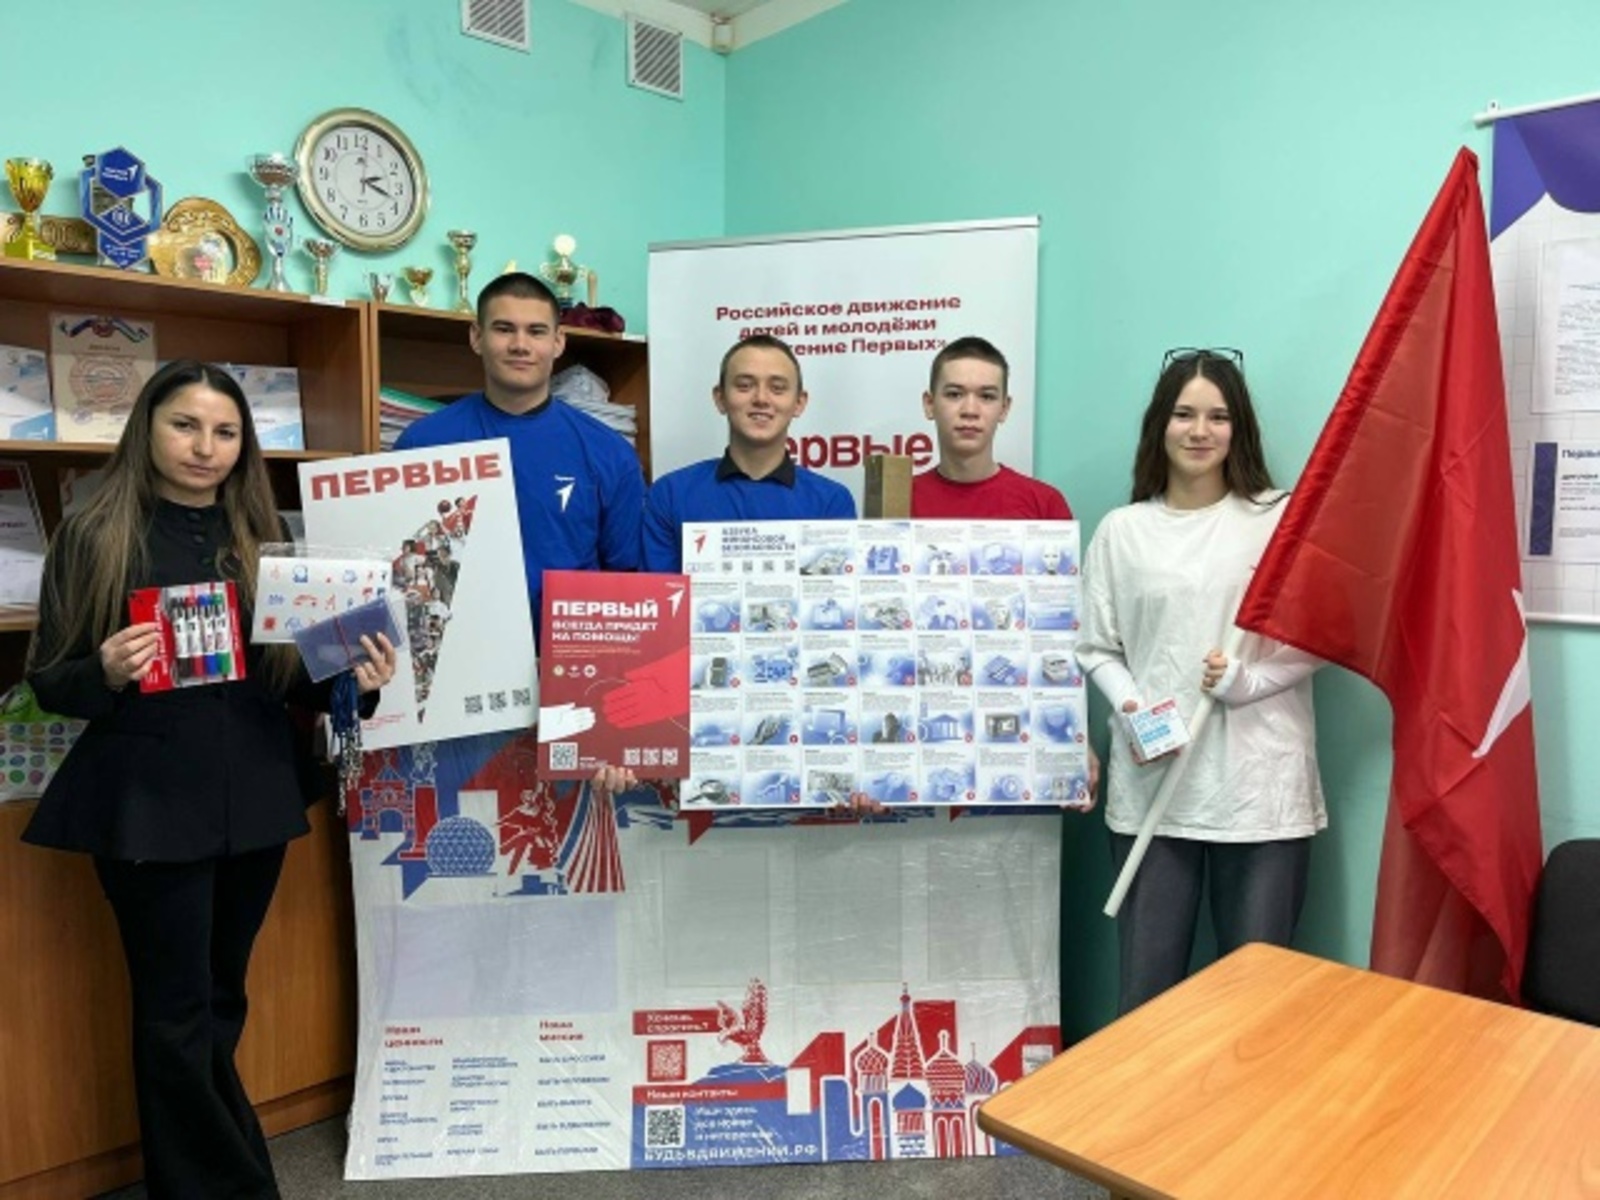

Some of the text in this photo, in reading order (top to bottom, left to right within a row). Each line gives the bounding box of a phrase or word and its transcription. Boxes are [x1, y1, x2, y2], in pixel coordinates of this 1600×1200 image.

[336, 134, 348, 150] 11
[354, 134, 368, 151] 12
[324, 147, 337, 162] 10
[319, 166, 328, 180] 9
[390, 162, 398, 175] 2
[327, 188, 335, 202] 8
[394, 182, 403, 196] 3
[339, 205, 348, 220] 7
[390, 202, 398, 215] 4
[359, 214, 368, 227] 6
[377, 213, 386, 227] 5
[716, 296, 961, 321] Российское движение
[804, 325, 817, 336] и
[822, 317, 936, 336] молодёжи
[787, 432, 933, 468] ервые
[311, 453, 502, 500] ПЕРВЫЕ
[552, 598, 658, 618] ПЕРВЫЙ
[552, 621, 603, 631] ВСЕГДА
[552, 632, 570, 641] НА
